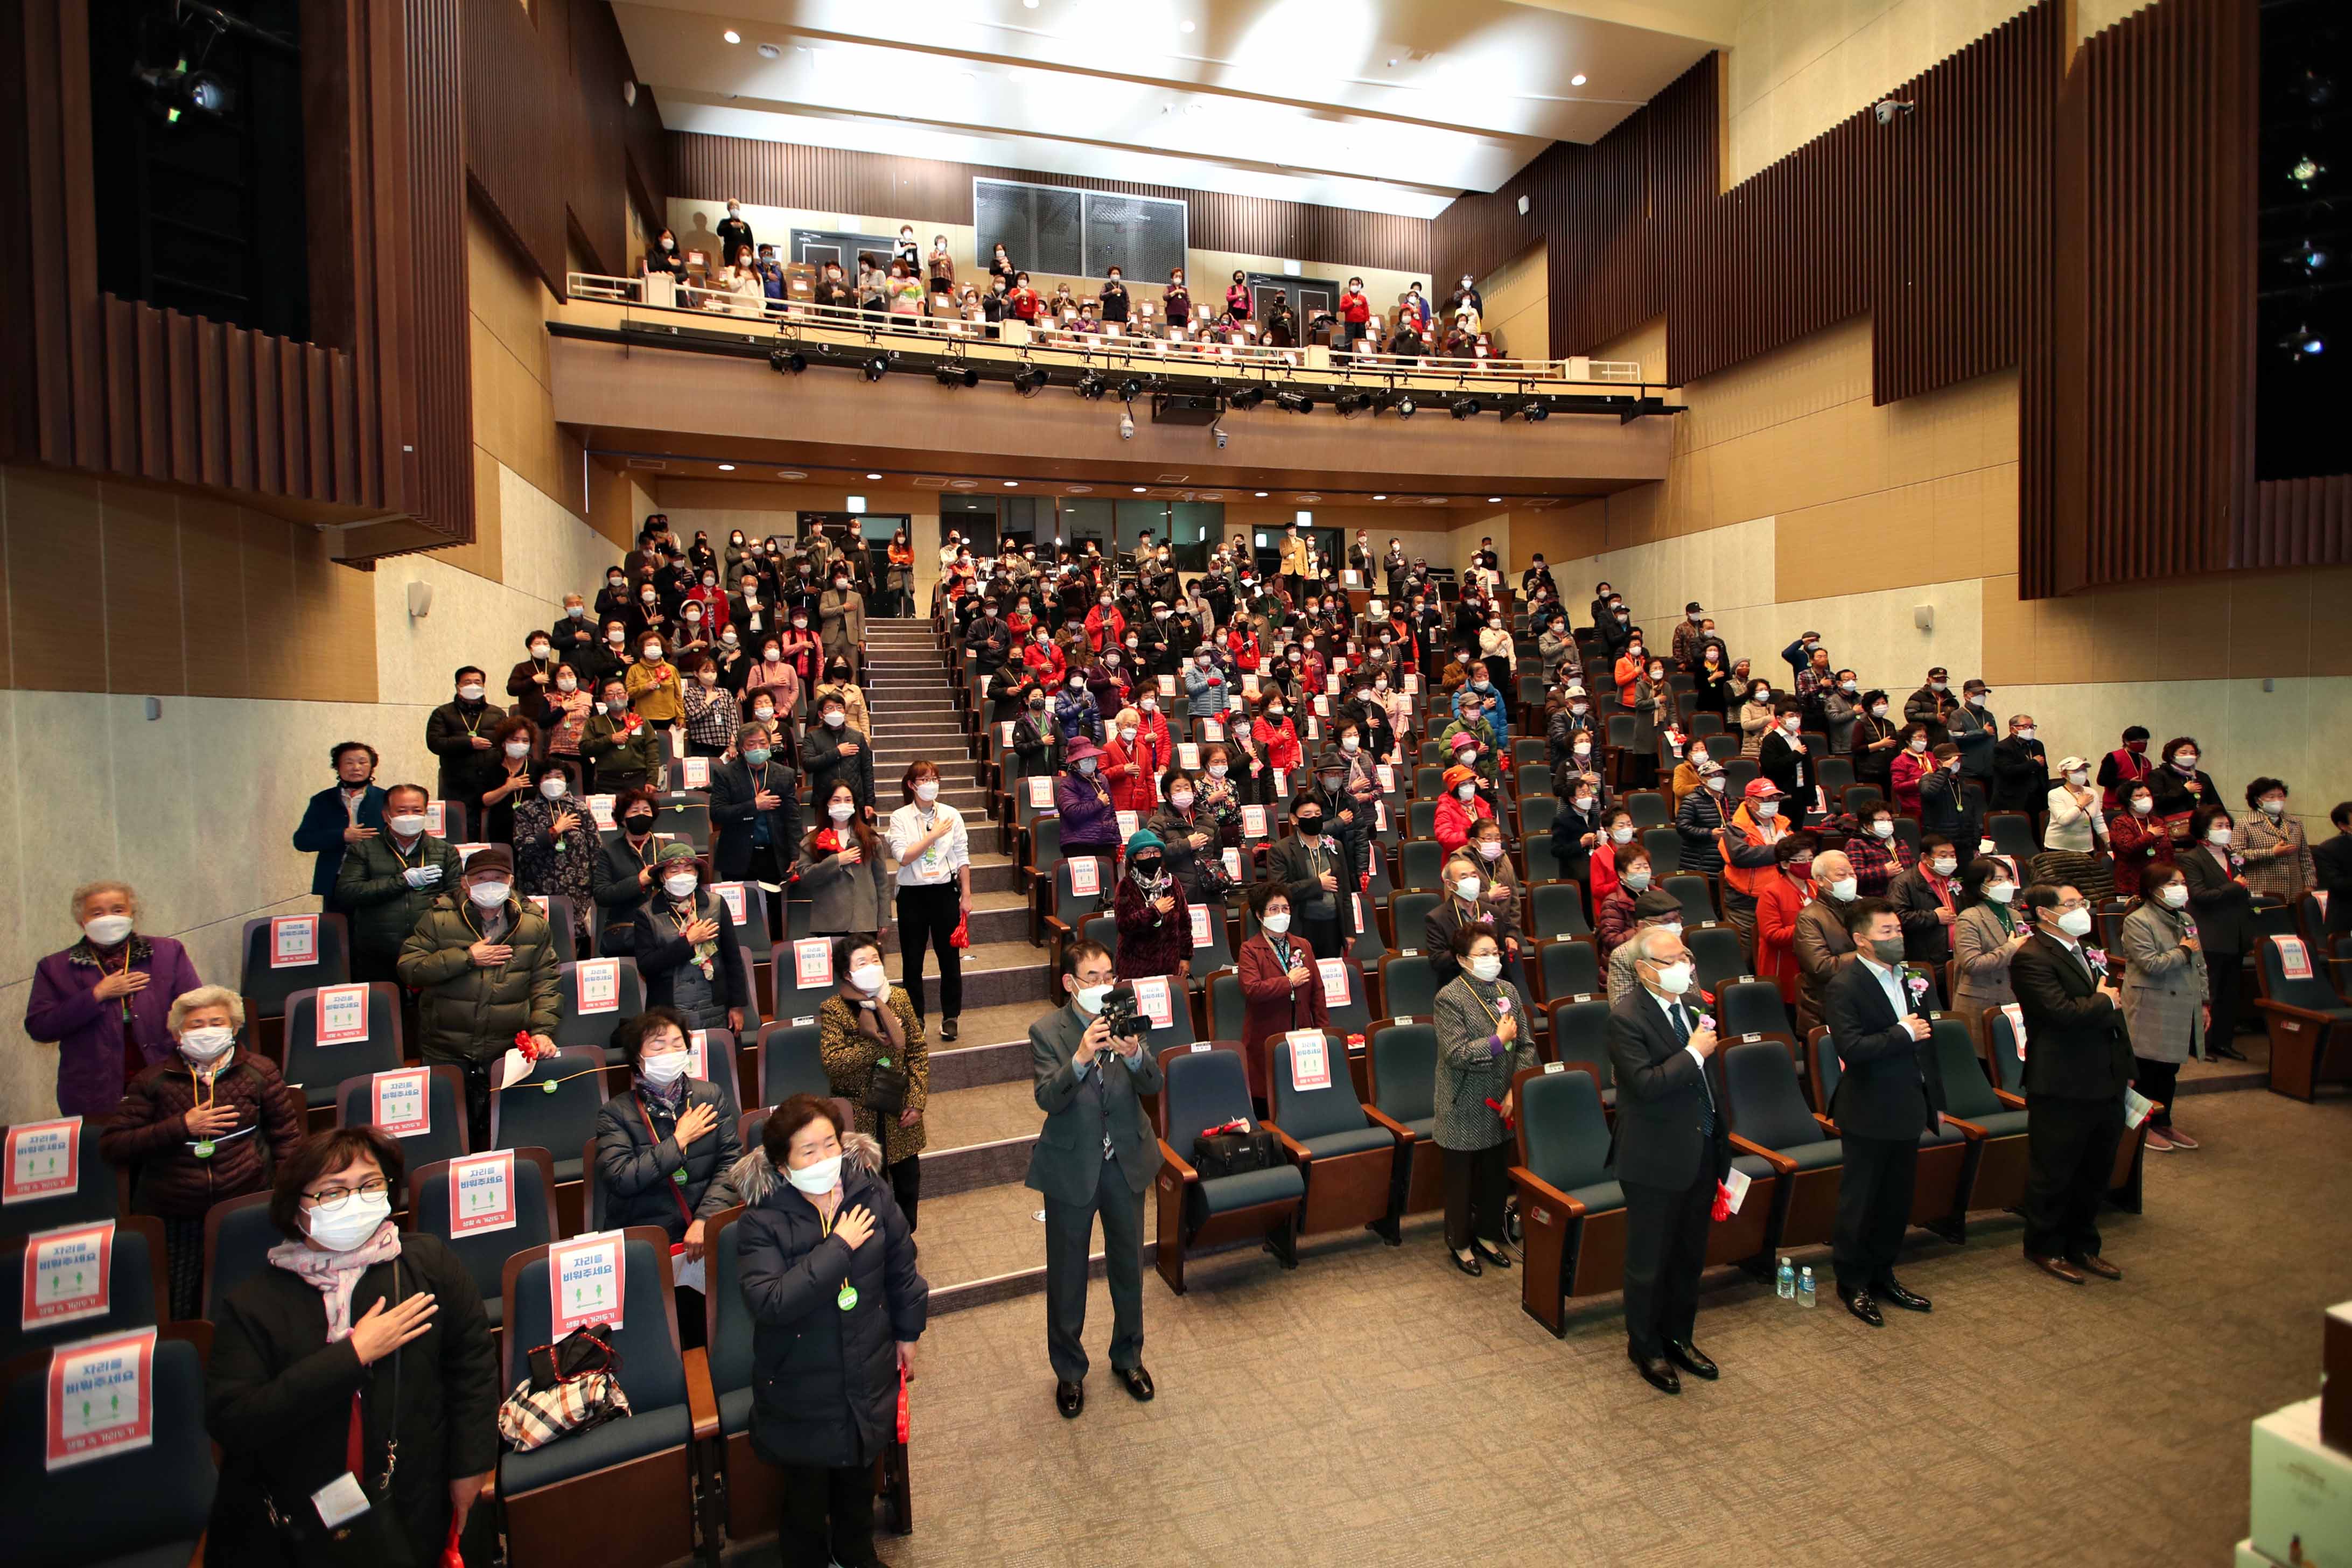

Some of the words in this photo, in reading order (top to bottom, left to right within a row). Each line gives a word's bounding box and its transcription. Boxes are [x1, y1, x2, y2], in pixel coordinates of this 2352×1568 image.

[326, 1002, 359, 1011] 비워주세요
[390, 1081, 412, 1089] 자리를
[382, 1089, 419, 1099] 비워주세요
[30, 1133, 58, 1144] 자리를
[17, 1142, 66, 1156] 비워주세요
[470, 1166, 495, 1177] 자리를
[460, 1176, 503, 1188] 비워주세요
[53, 1243, 86, 1254] 자리를
[39, 1252, 96, 1270] 비워주세요
[573, 1254, 603, 1267] 자리를
[563, 1264, 612, 1282] 비워주세요
[82, 1358, 122, 1375] 자리를
[66, 1370, 134, 1395] 비워주세요
